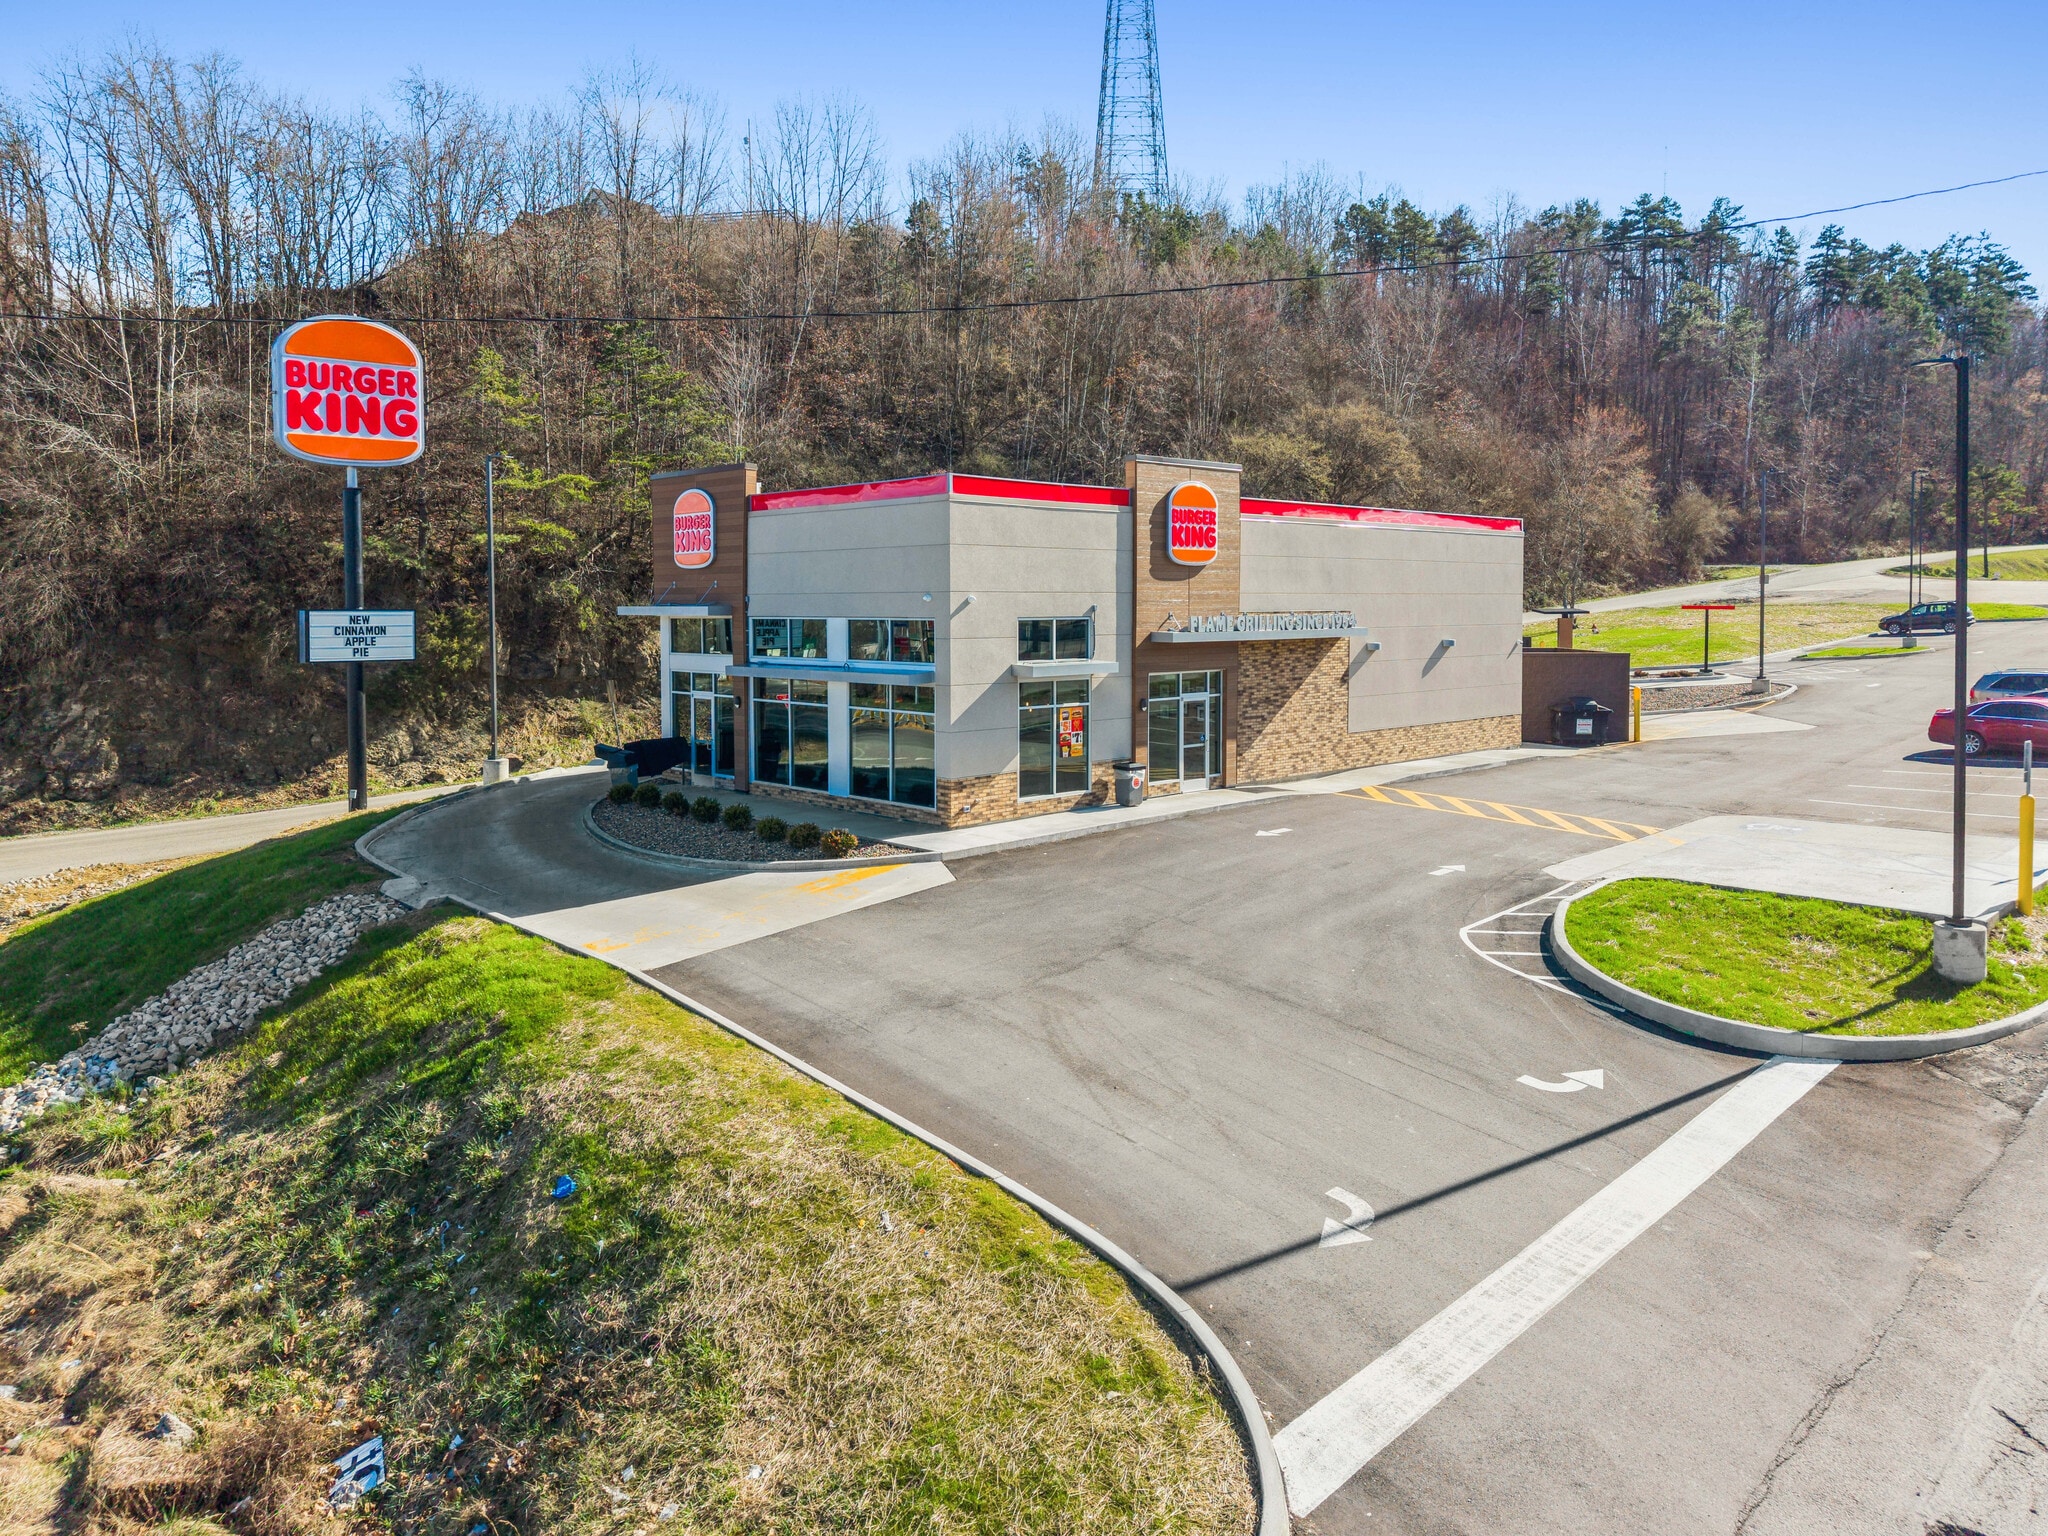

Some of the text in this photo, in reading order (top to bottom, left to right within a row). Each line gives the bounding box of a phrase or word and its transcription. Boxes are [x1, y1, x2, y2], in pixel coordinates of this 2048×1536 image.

[285, 359, 417, 398] BURGER
[286, 389, 419, 437] KING
[674, 514, 711, 532] BURGER
[1171, 508, 1216, 526] BURGER
[674, 530, 711, 553] KING
[1171, 525, 1216, 548] KING
[349, 615, 370, 625] NEW
[1190, 615, 1234, 632] FLAME
[1237, 613, 1294, 632] GRILLING
[1294, 613, 1329, 631] SINCE
[334, 626, 387, 636] CINNAMON
[344, 637, 377, 646] APPLE
[352, 648, 369, 657] PIE
